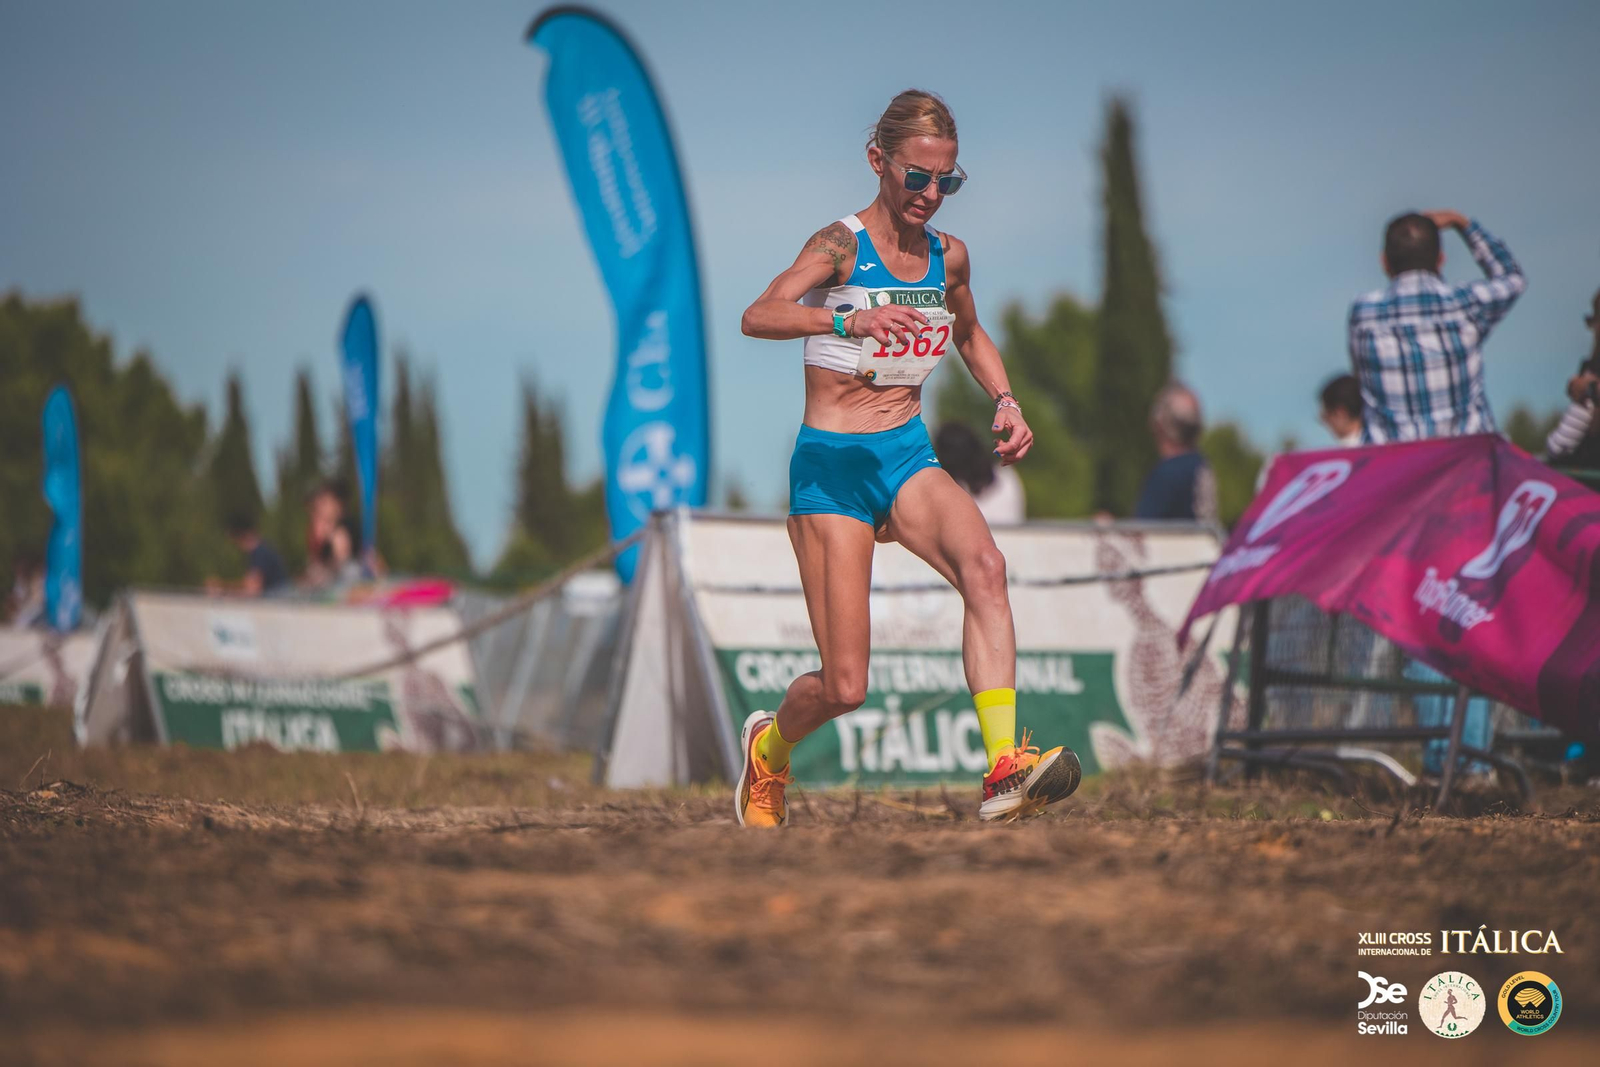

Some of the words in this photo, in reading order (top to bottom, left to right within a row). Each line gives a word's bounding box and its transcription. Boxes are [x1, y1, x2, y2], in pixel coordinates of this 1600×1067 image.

[895, 291, 938, 305] ITÁLICA
[872, 325, 950, 358] 1562
[735, 652, 823, 694] CRO
[833, 693, 988, 774] ITÁLIC
